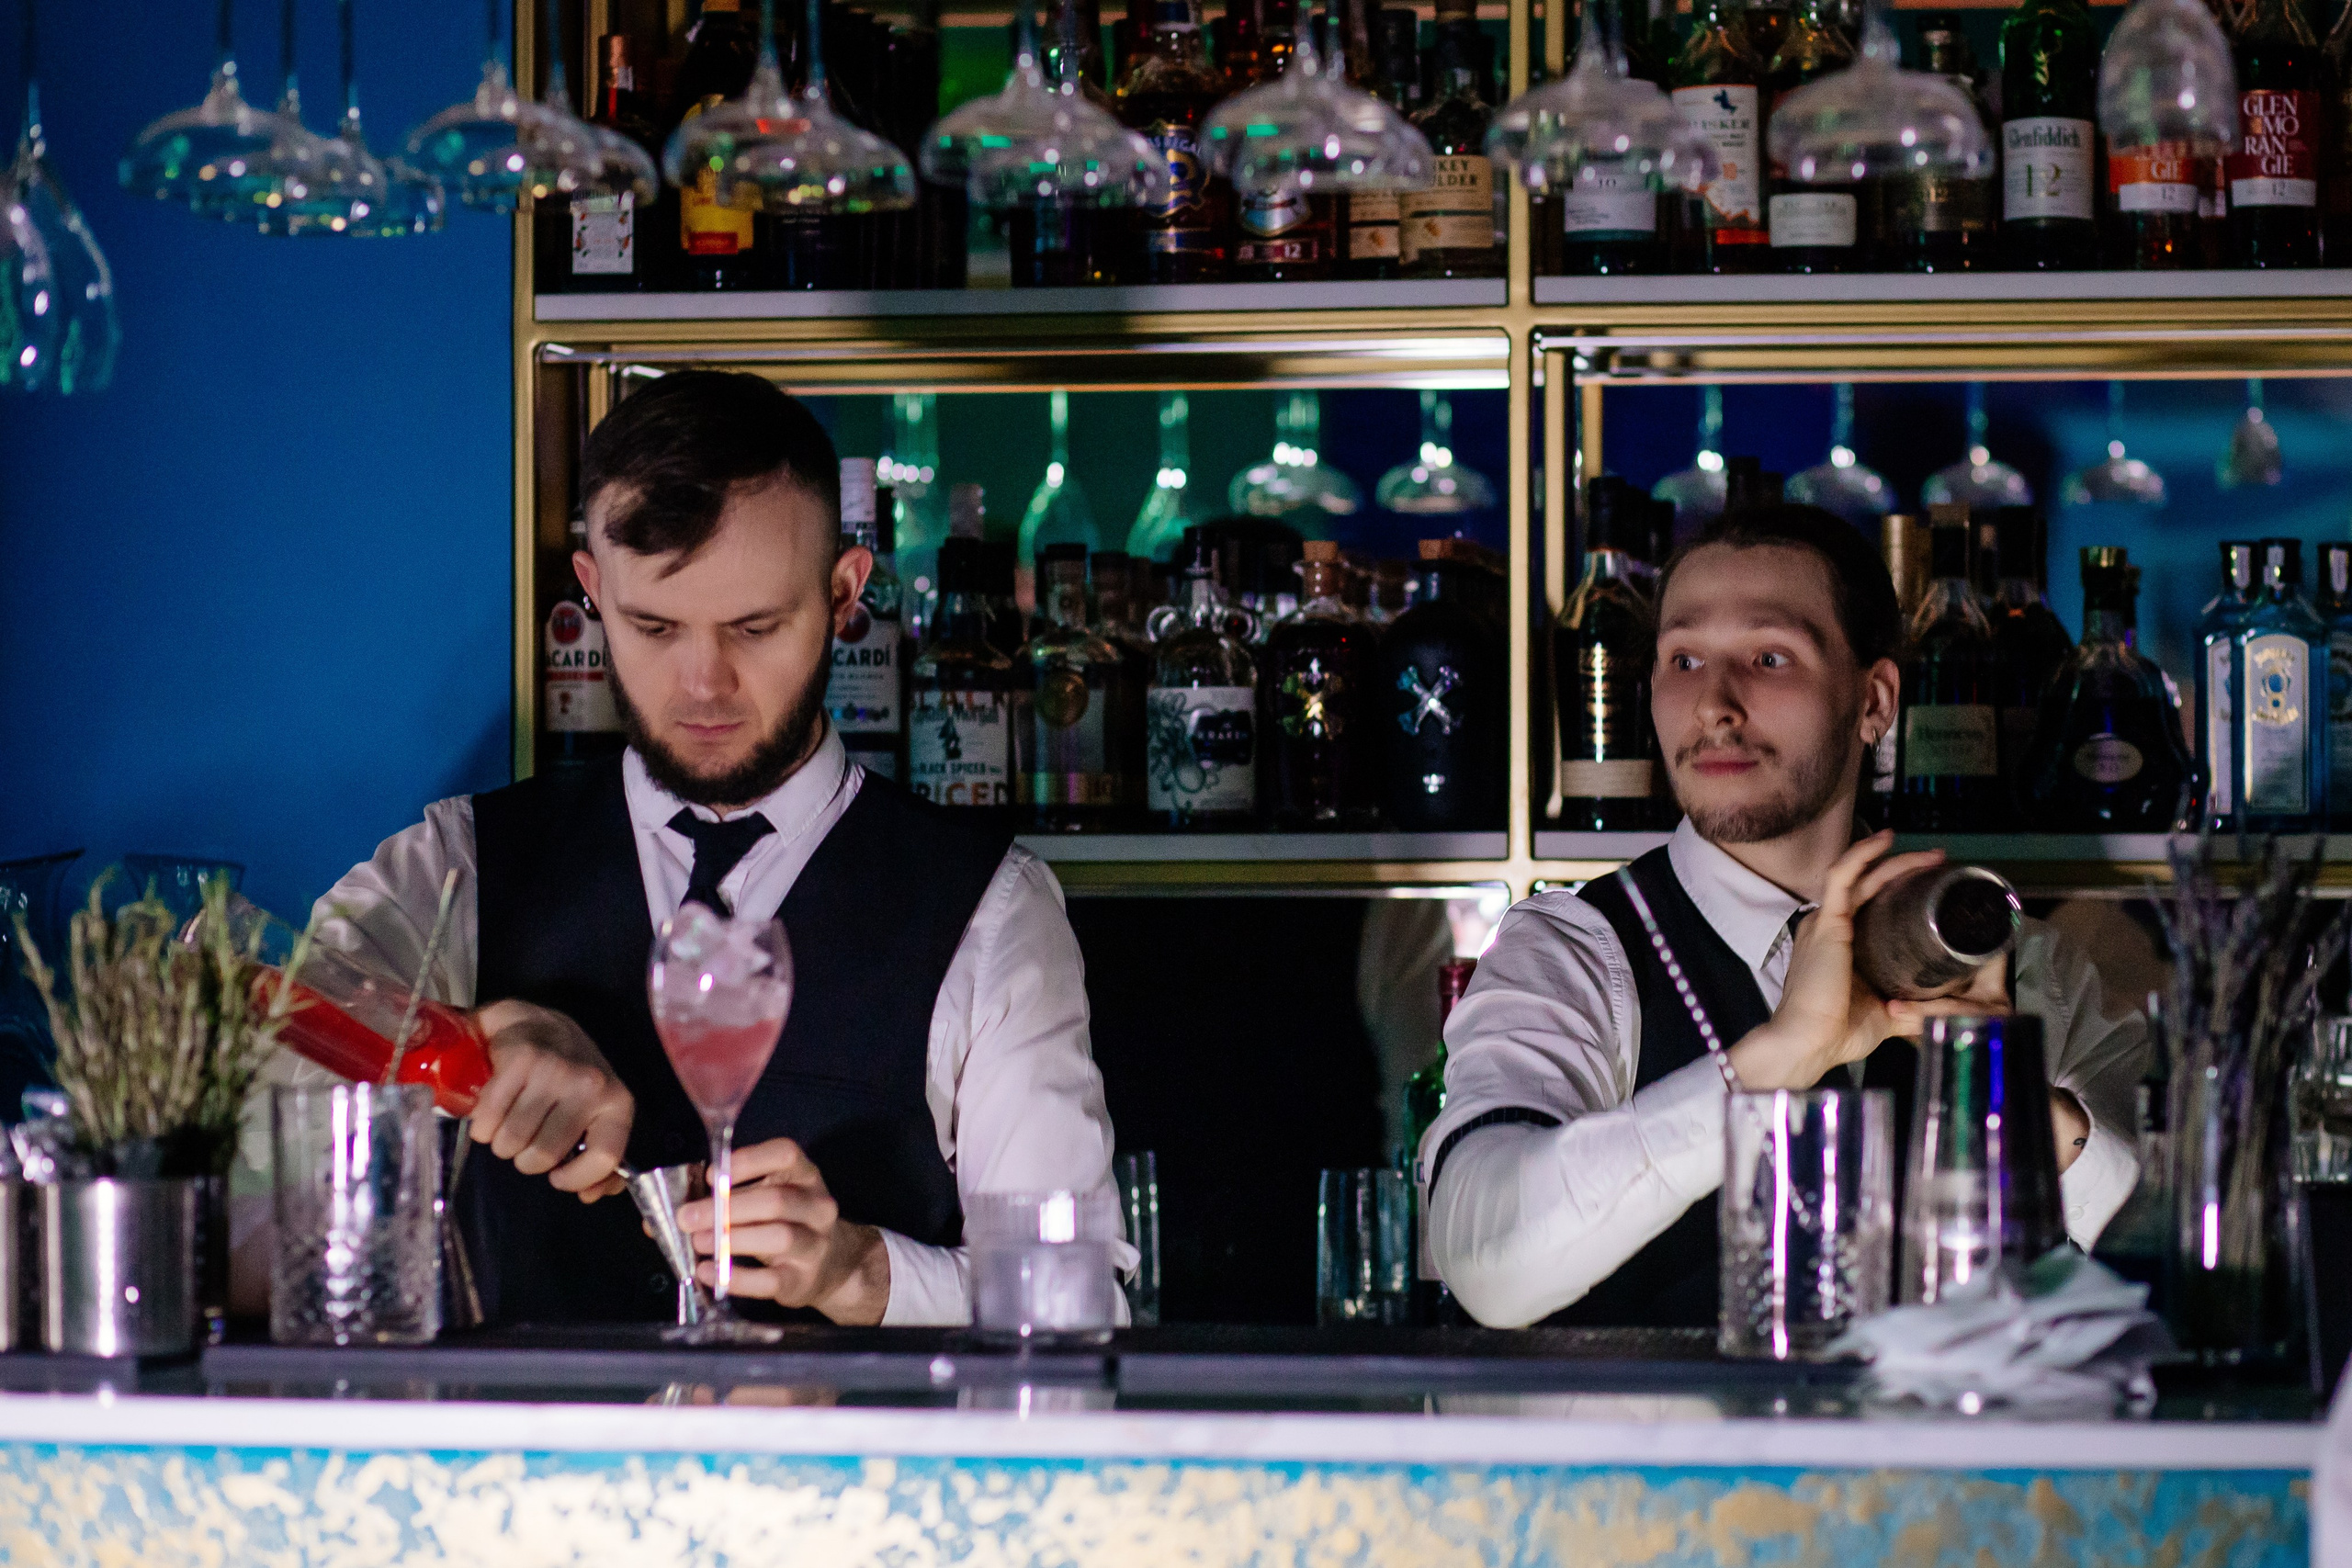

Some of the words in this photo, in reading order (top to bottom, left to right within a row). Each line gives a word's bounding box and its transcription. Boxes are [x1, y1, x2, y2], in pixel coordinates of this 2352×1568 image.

[2243, 94, 2298, 117] GLEN
[2261, 116, 2300, 136] MO
[2245, 136, 2287, 155] RAN
[2260, 155, 2295, 175] GIE
[2026, 164, 2062, 197] 12
[1283, 243, 1302, 258] 12
[831, 645, 891, 667] CARDÍ
